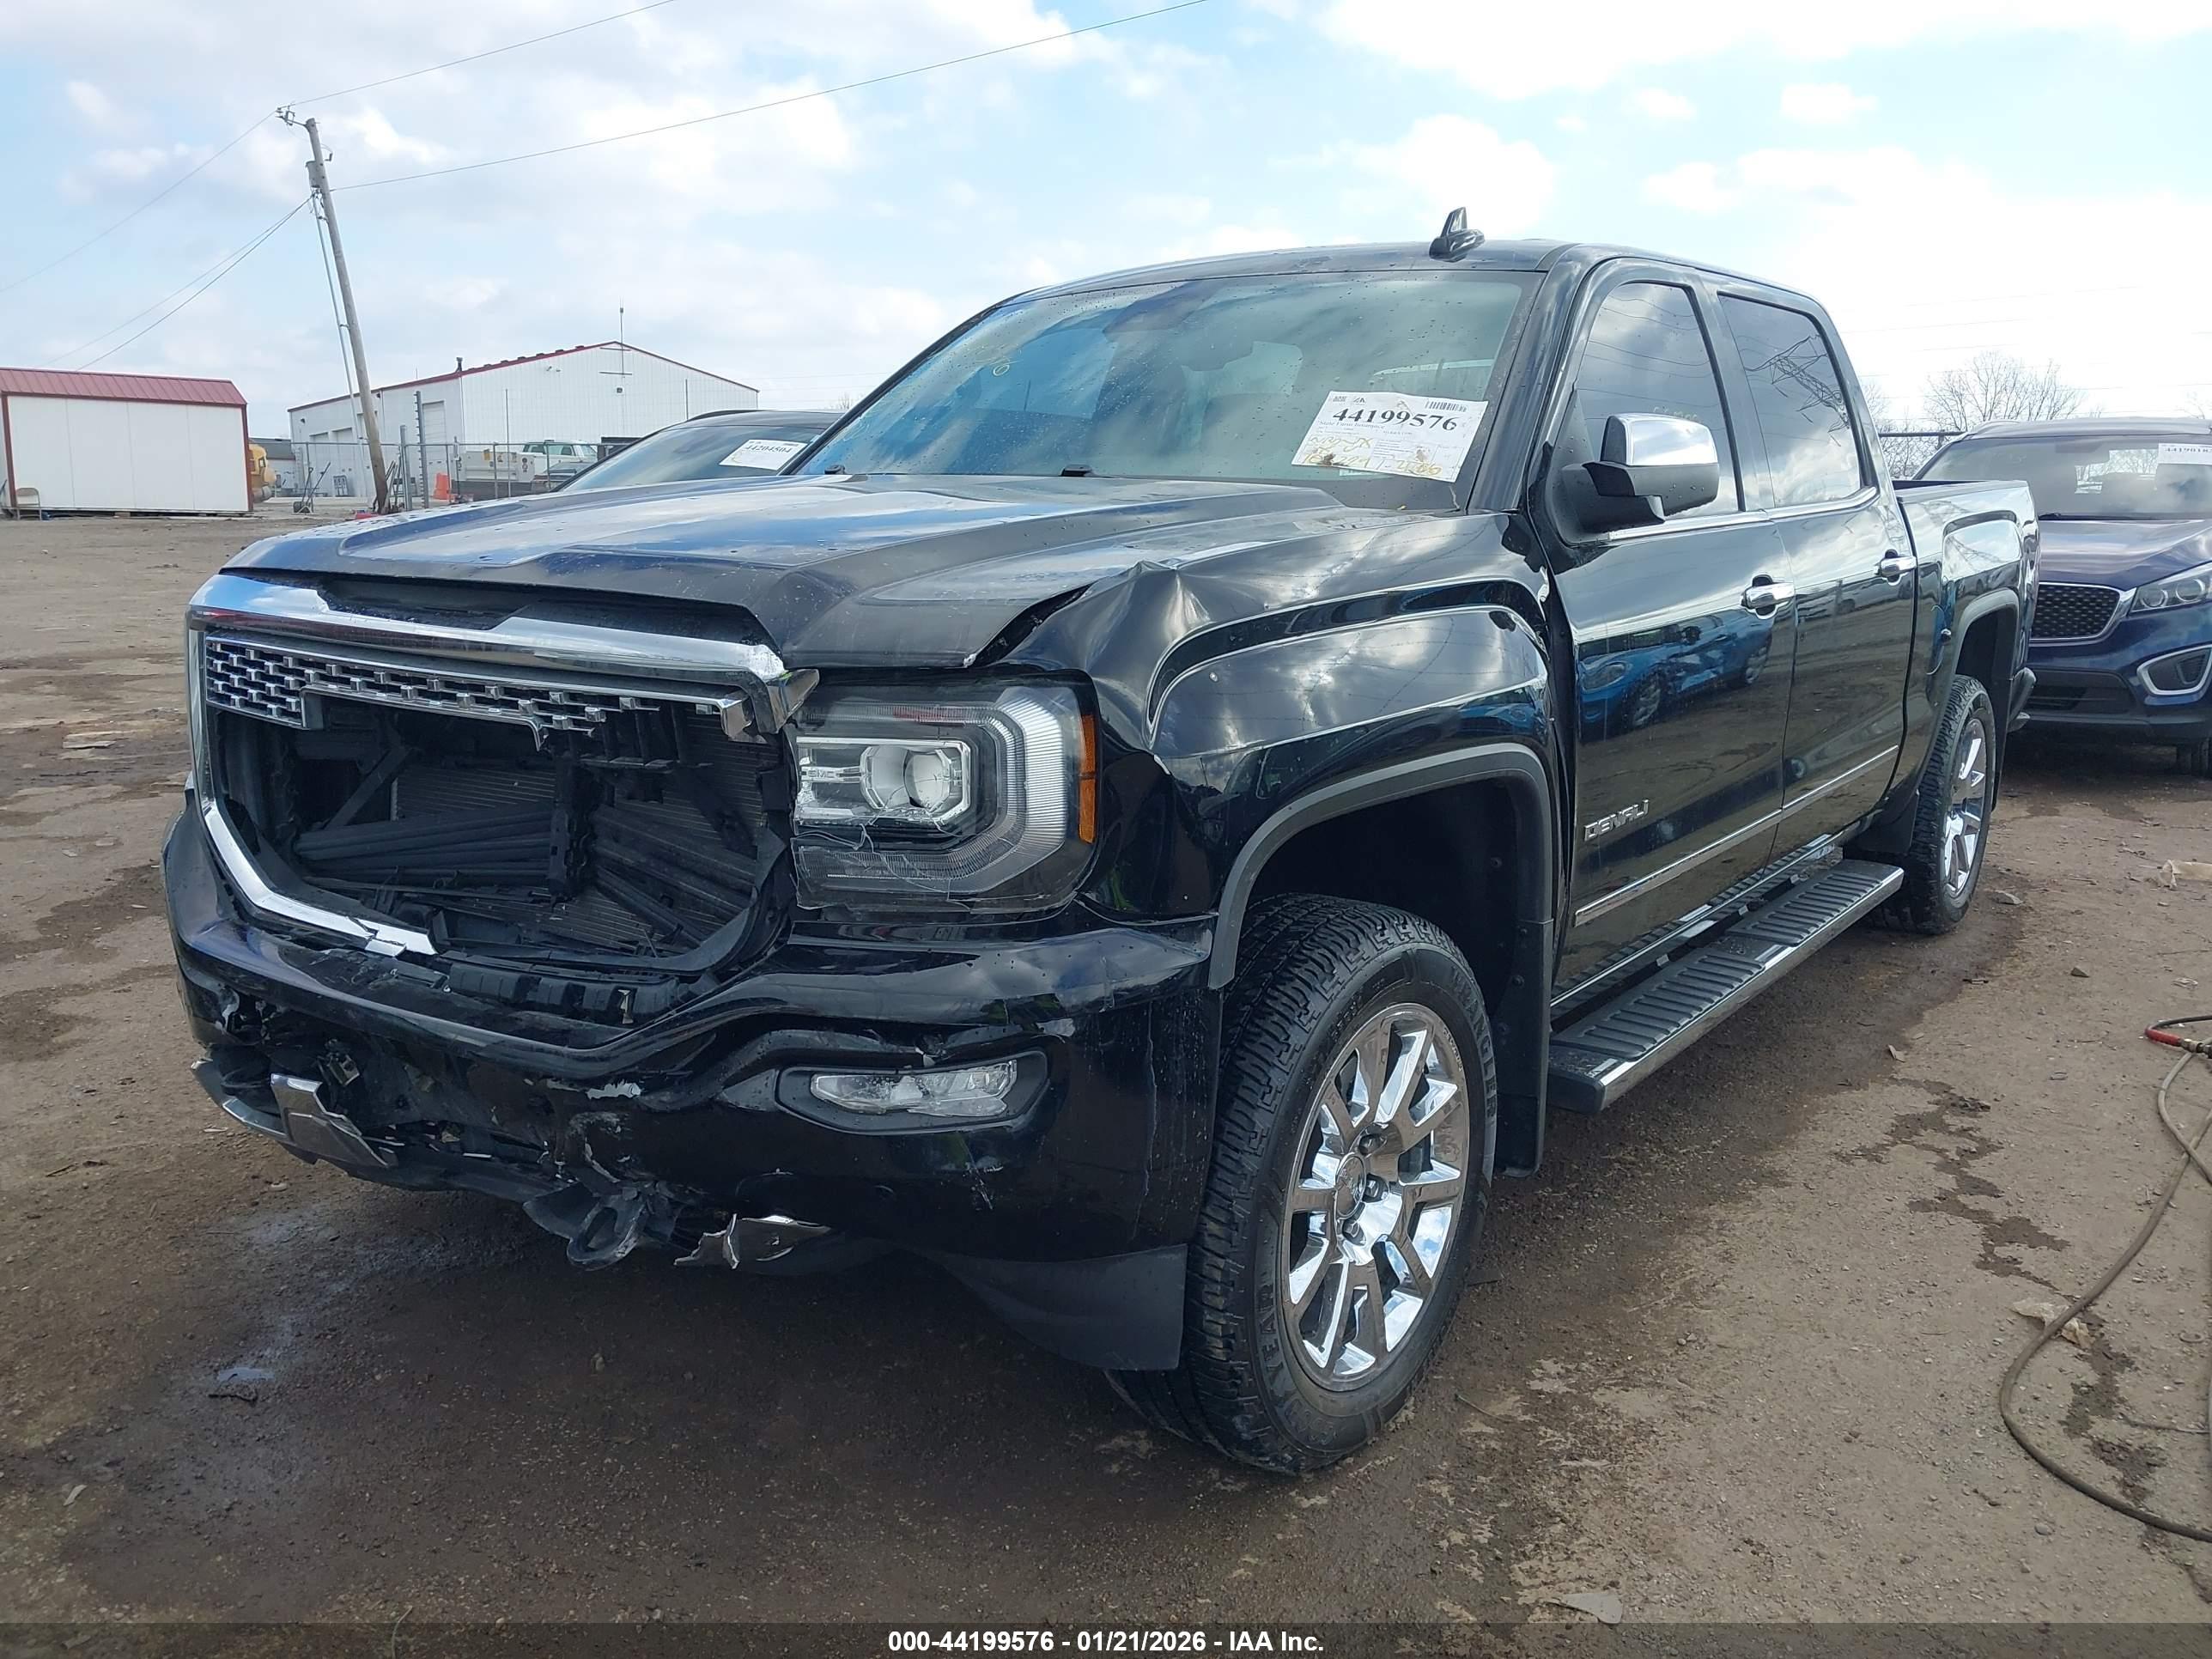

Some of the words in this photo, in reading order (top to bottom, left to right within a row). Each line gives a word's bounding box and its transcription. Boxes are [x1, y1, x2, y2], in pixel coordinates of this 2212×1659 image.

[1332, 408, 1461, 431] 44199576
[807, 769, 835, 778] GMC
[1583, 799, 1650, 842] DENALI
